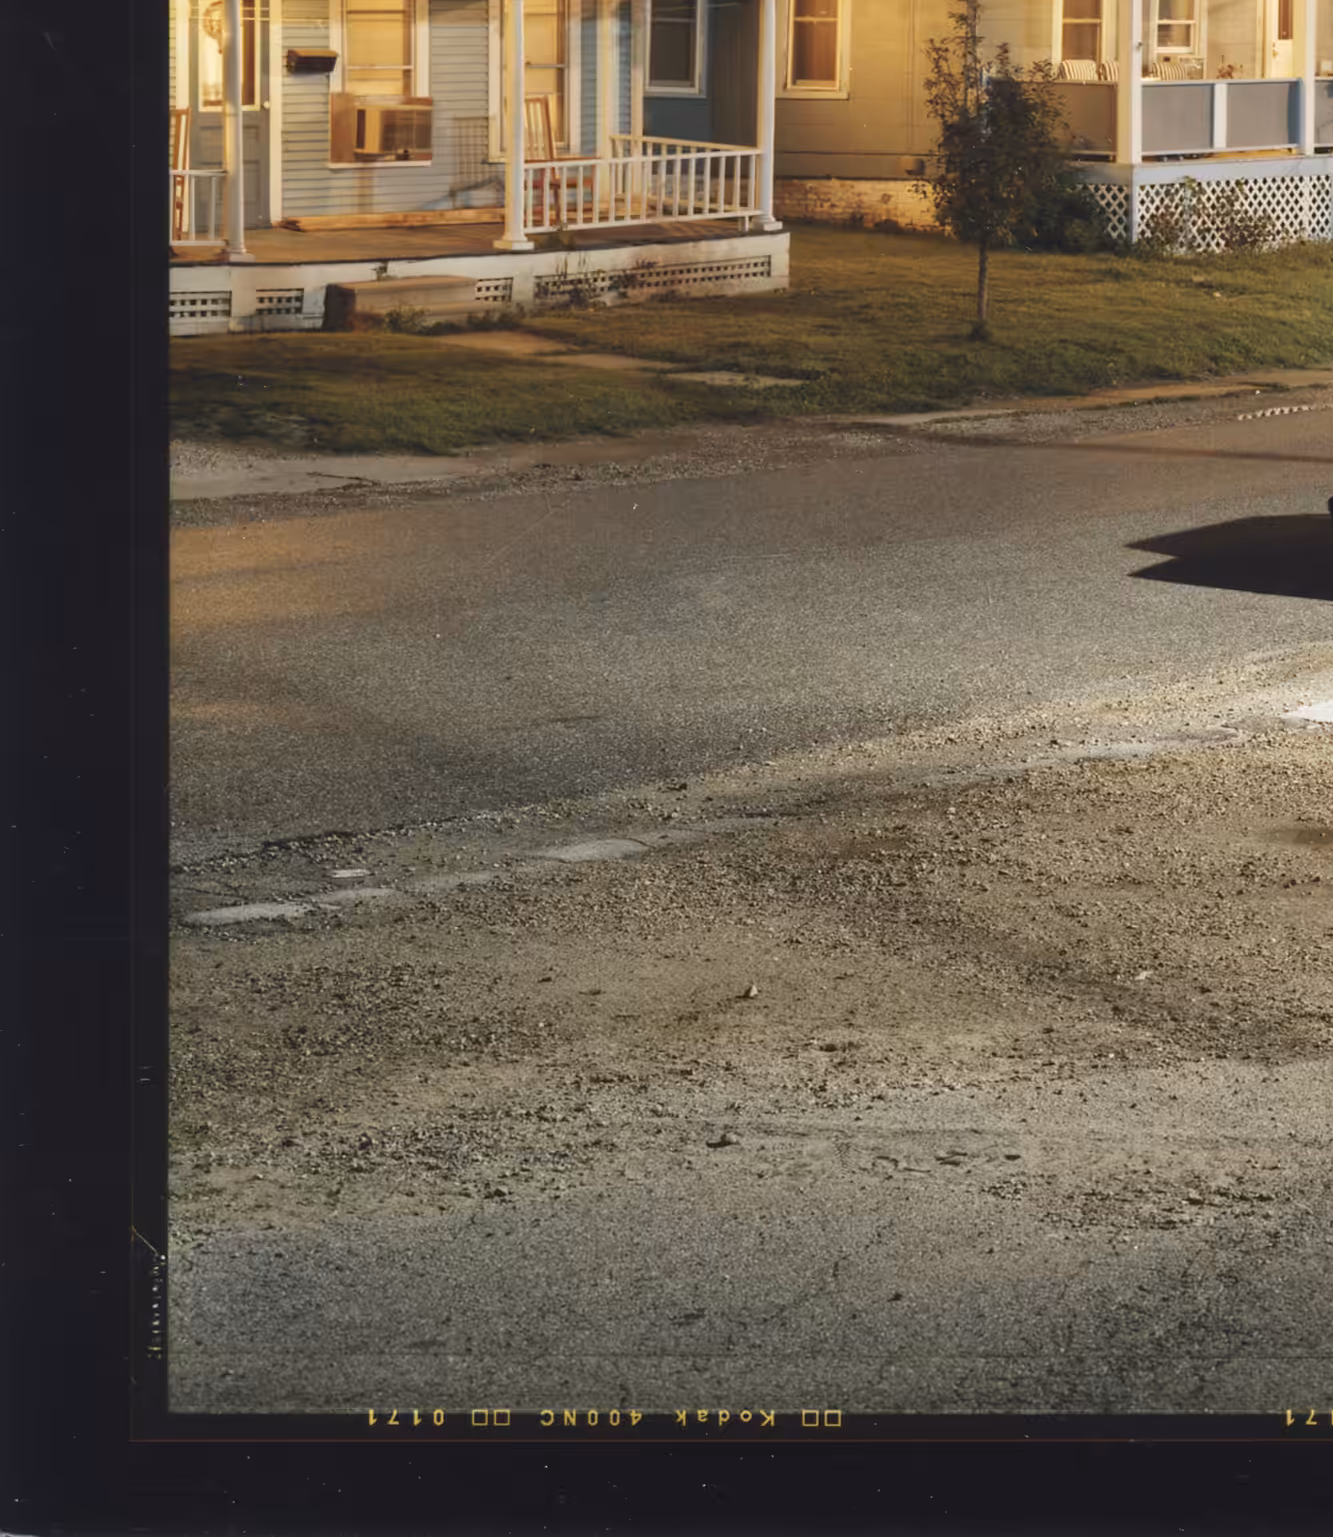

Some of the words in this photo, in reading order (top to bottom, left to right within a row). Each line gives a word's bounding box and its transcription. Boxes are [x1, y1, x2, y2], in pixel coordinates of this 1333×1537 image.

[367, 1408, 445, 1427] 0171
[541, 1408, 643, 1427] 400NC
[675, 1408, 775, 1427] Kodak
